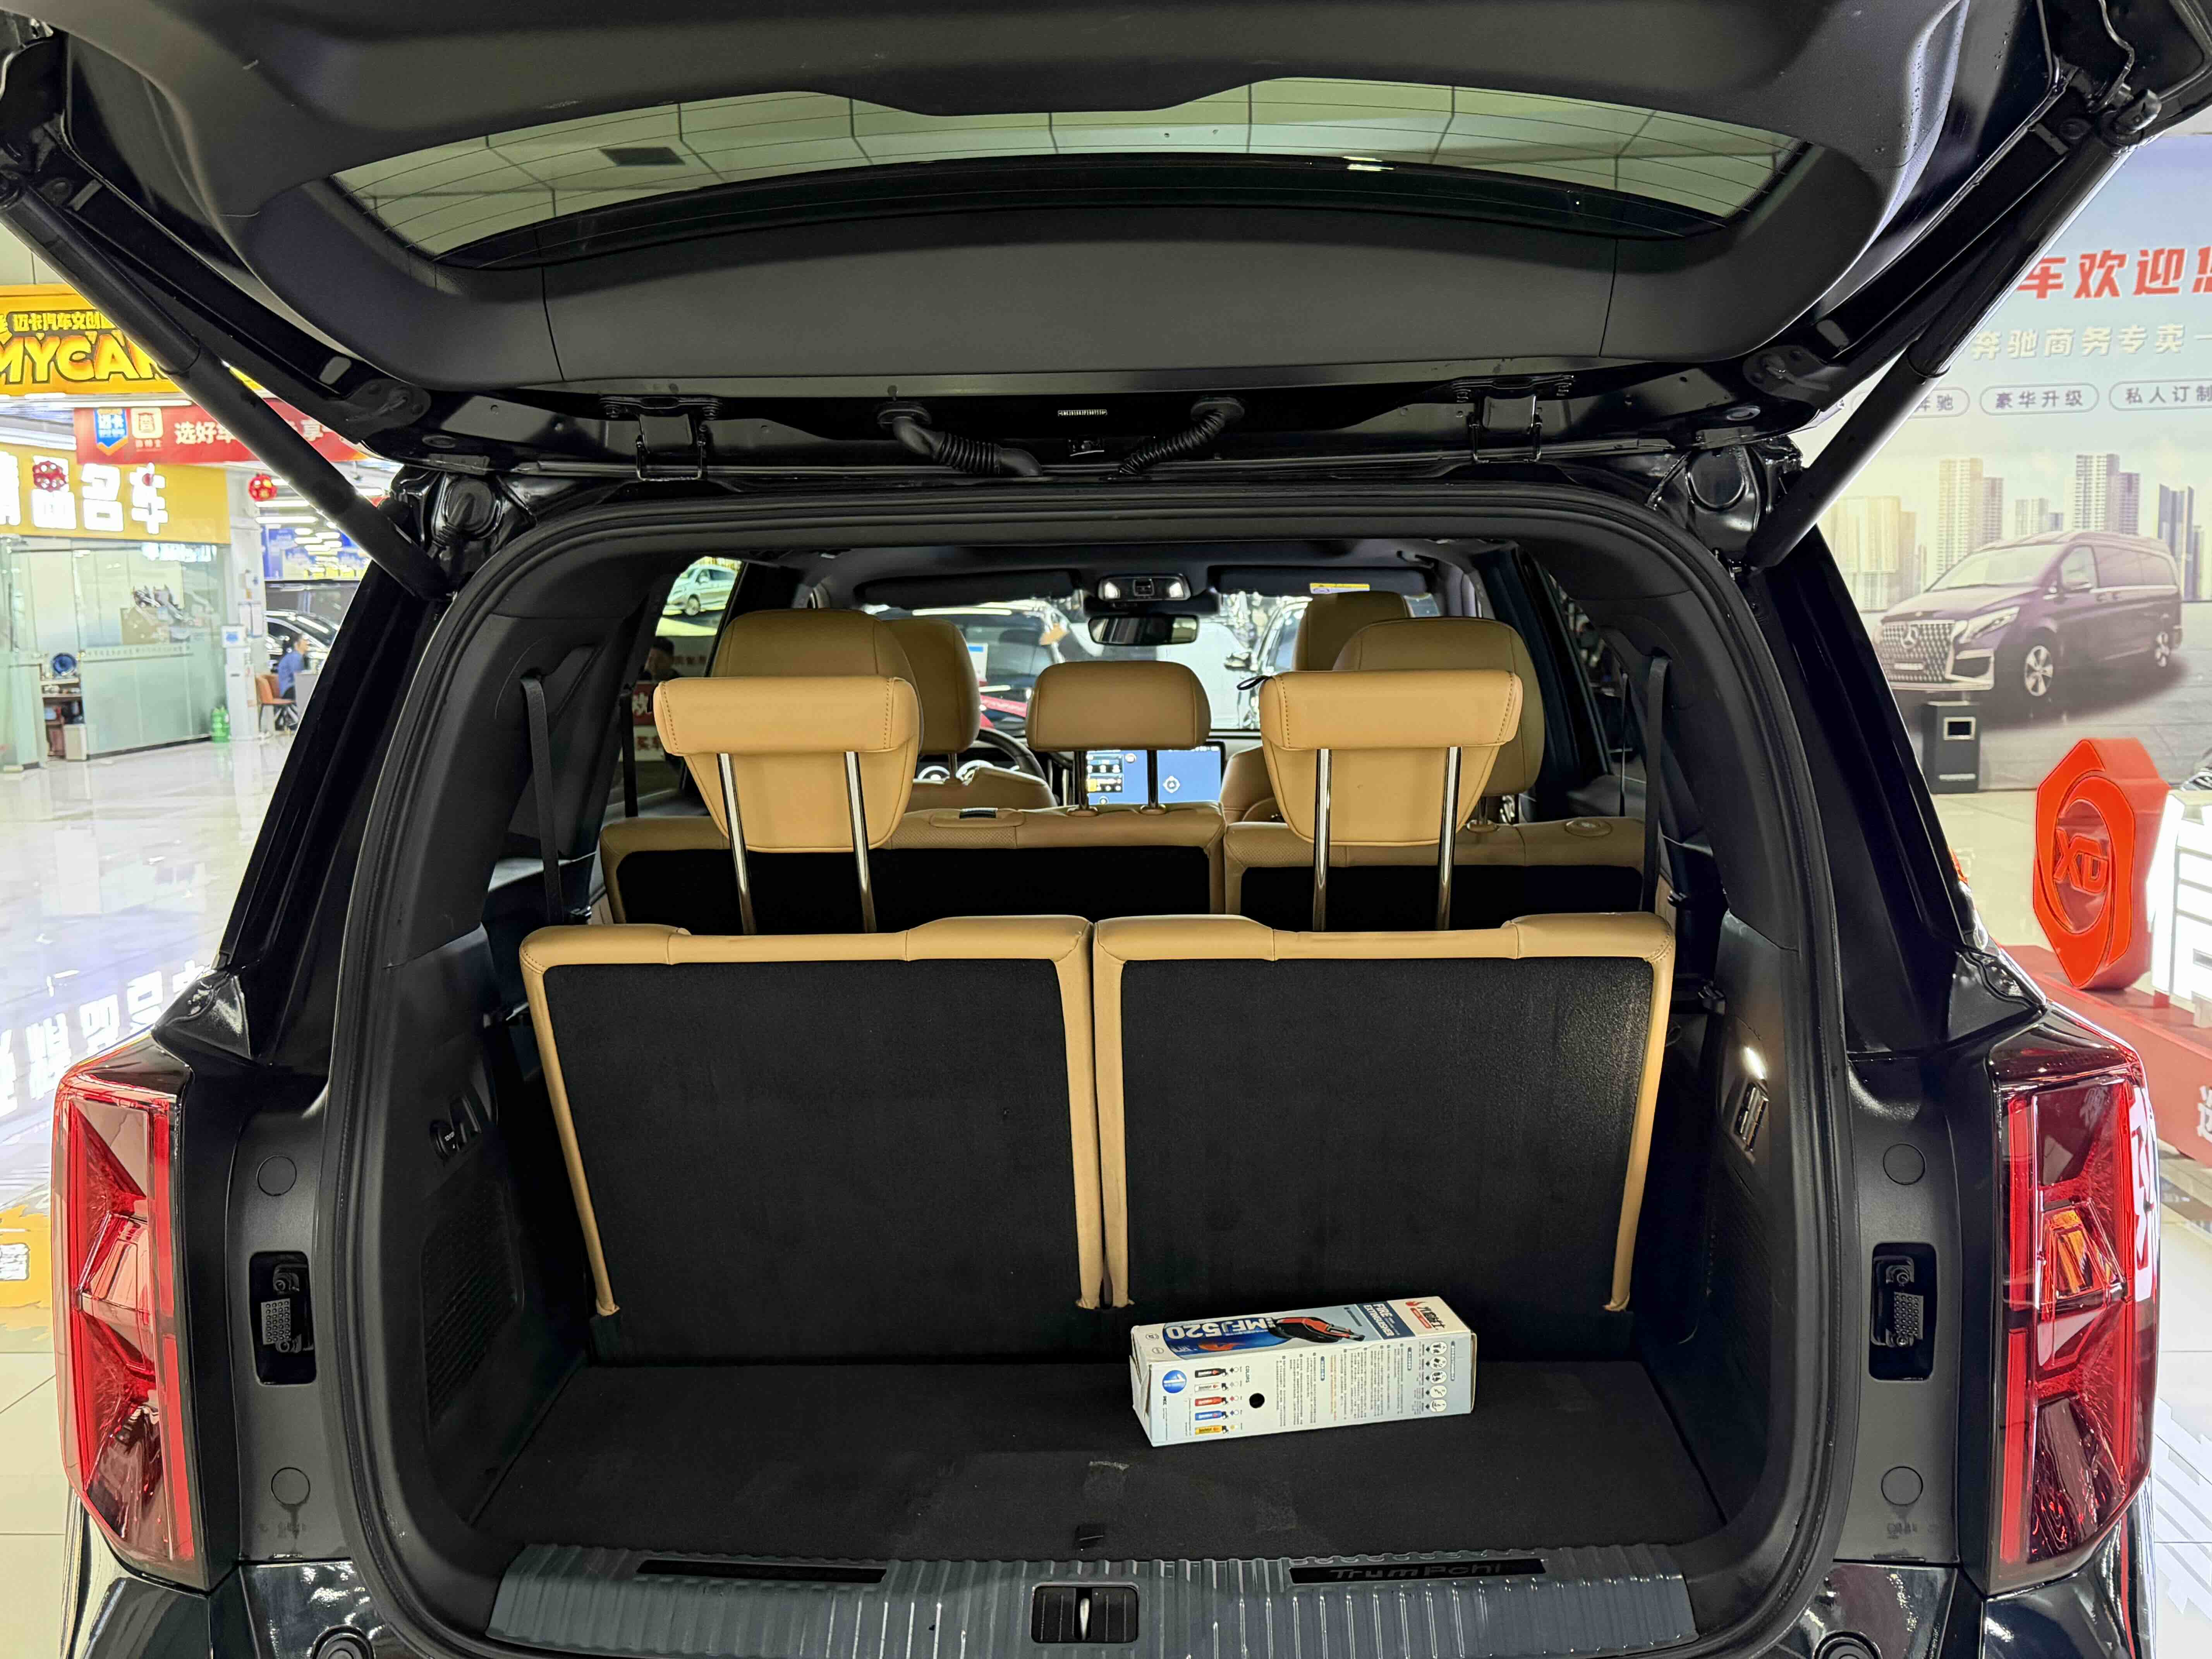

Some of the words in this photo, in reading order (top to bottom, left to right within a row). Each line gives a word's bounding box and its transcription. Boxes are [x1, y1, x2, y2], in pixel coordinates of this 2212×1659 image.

[1996, 390, 2083, 409] 豪华升级
[1373, 1303, 1393, 1317] FIRE
[1165, 1317, 1269, 1340] MFJ520
